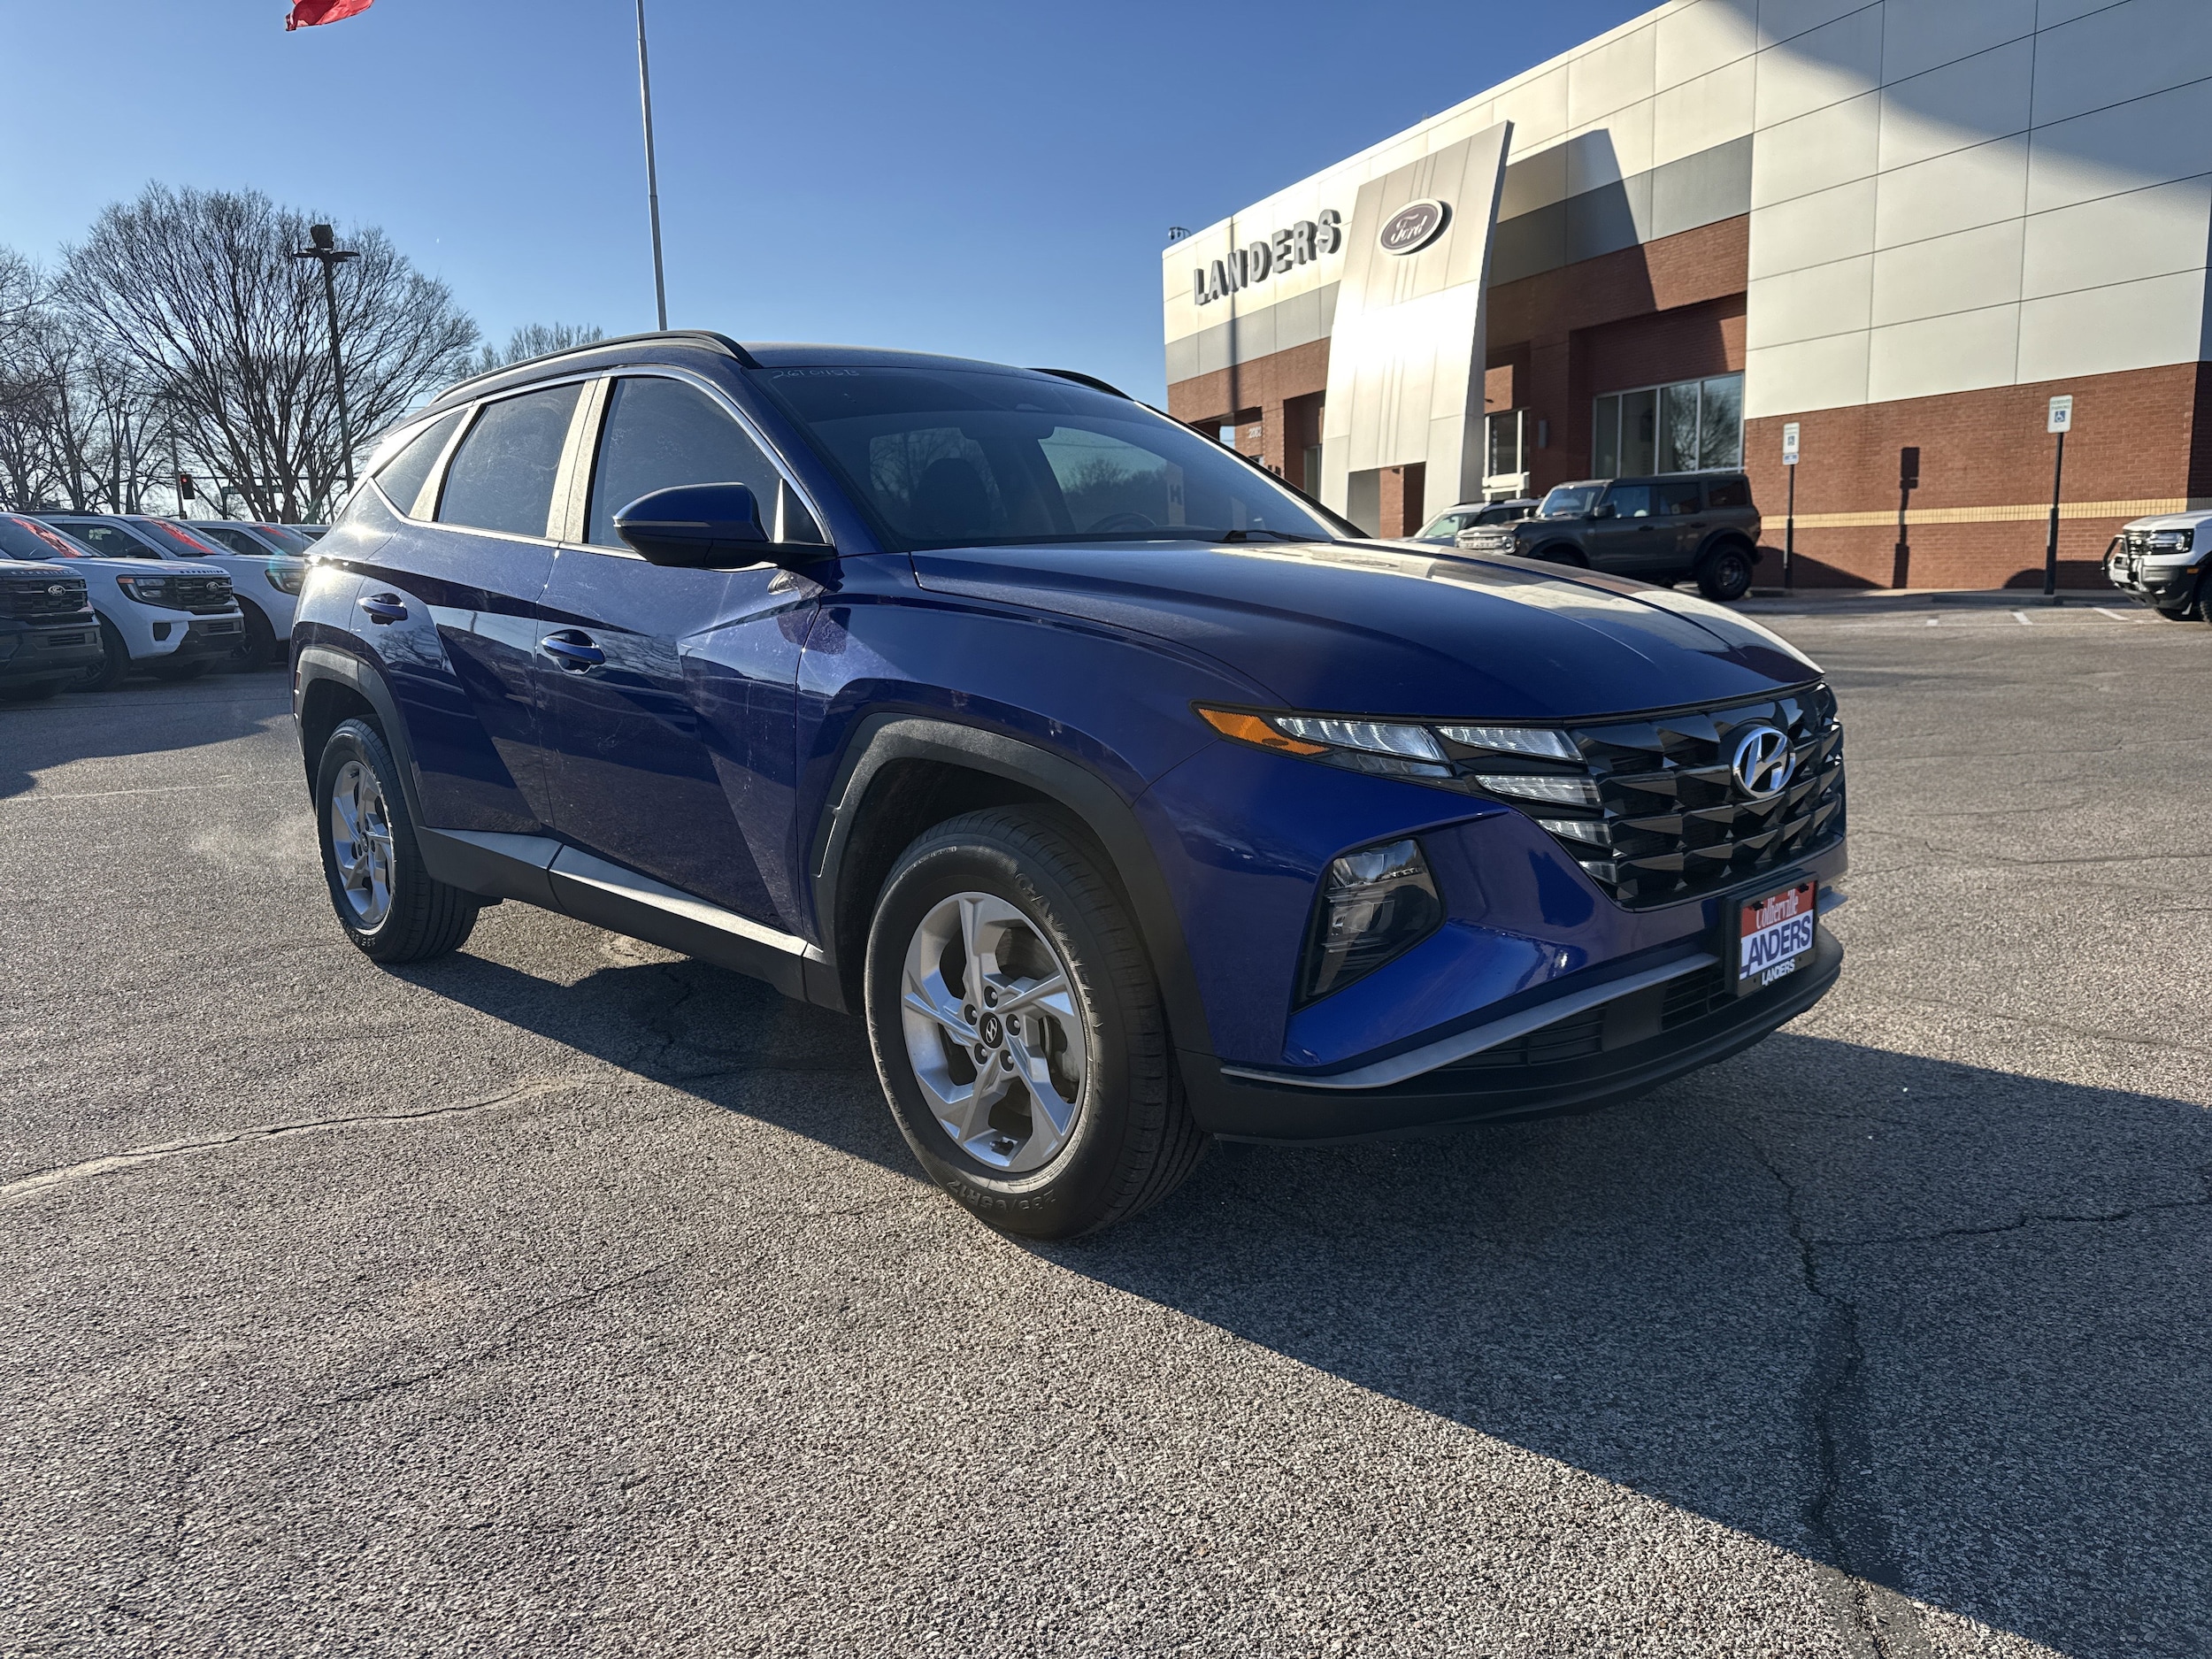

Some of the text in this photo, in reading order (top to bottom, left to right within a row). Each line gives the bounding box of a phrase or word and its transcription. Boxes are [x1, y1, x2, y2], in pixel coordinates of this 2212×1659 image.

[1390, 214, 1428, 245] Ford
[1194, 209, 1341, 306] LANDERS
[1756, 888, 1799, 929] Collierville
[1762, 958, 1795, 986] LANDERS
